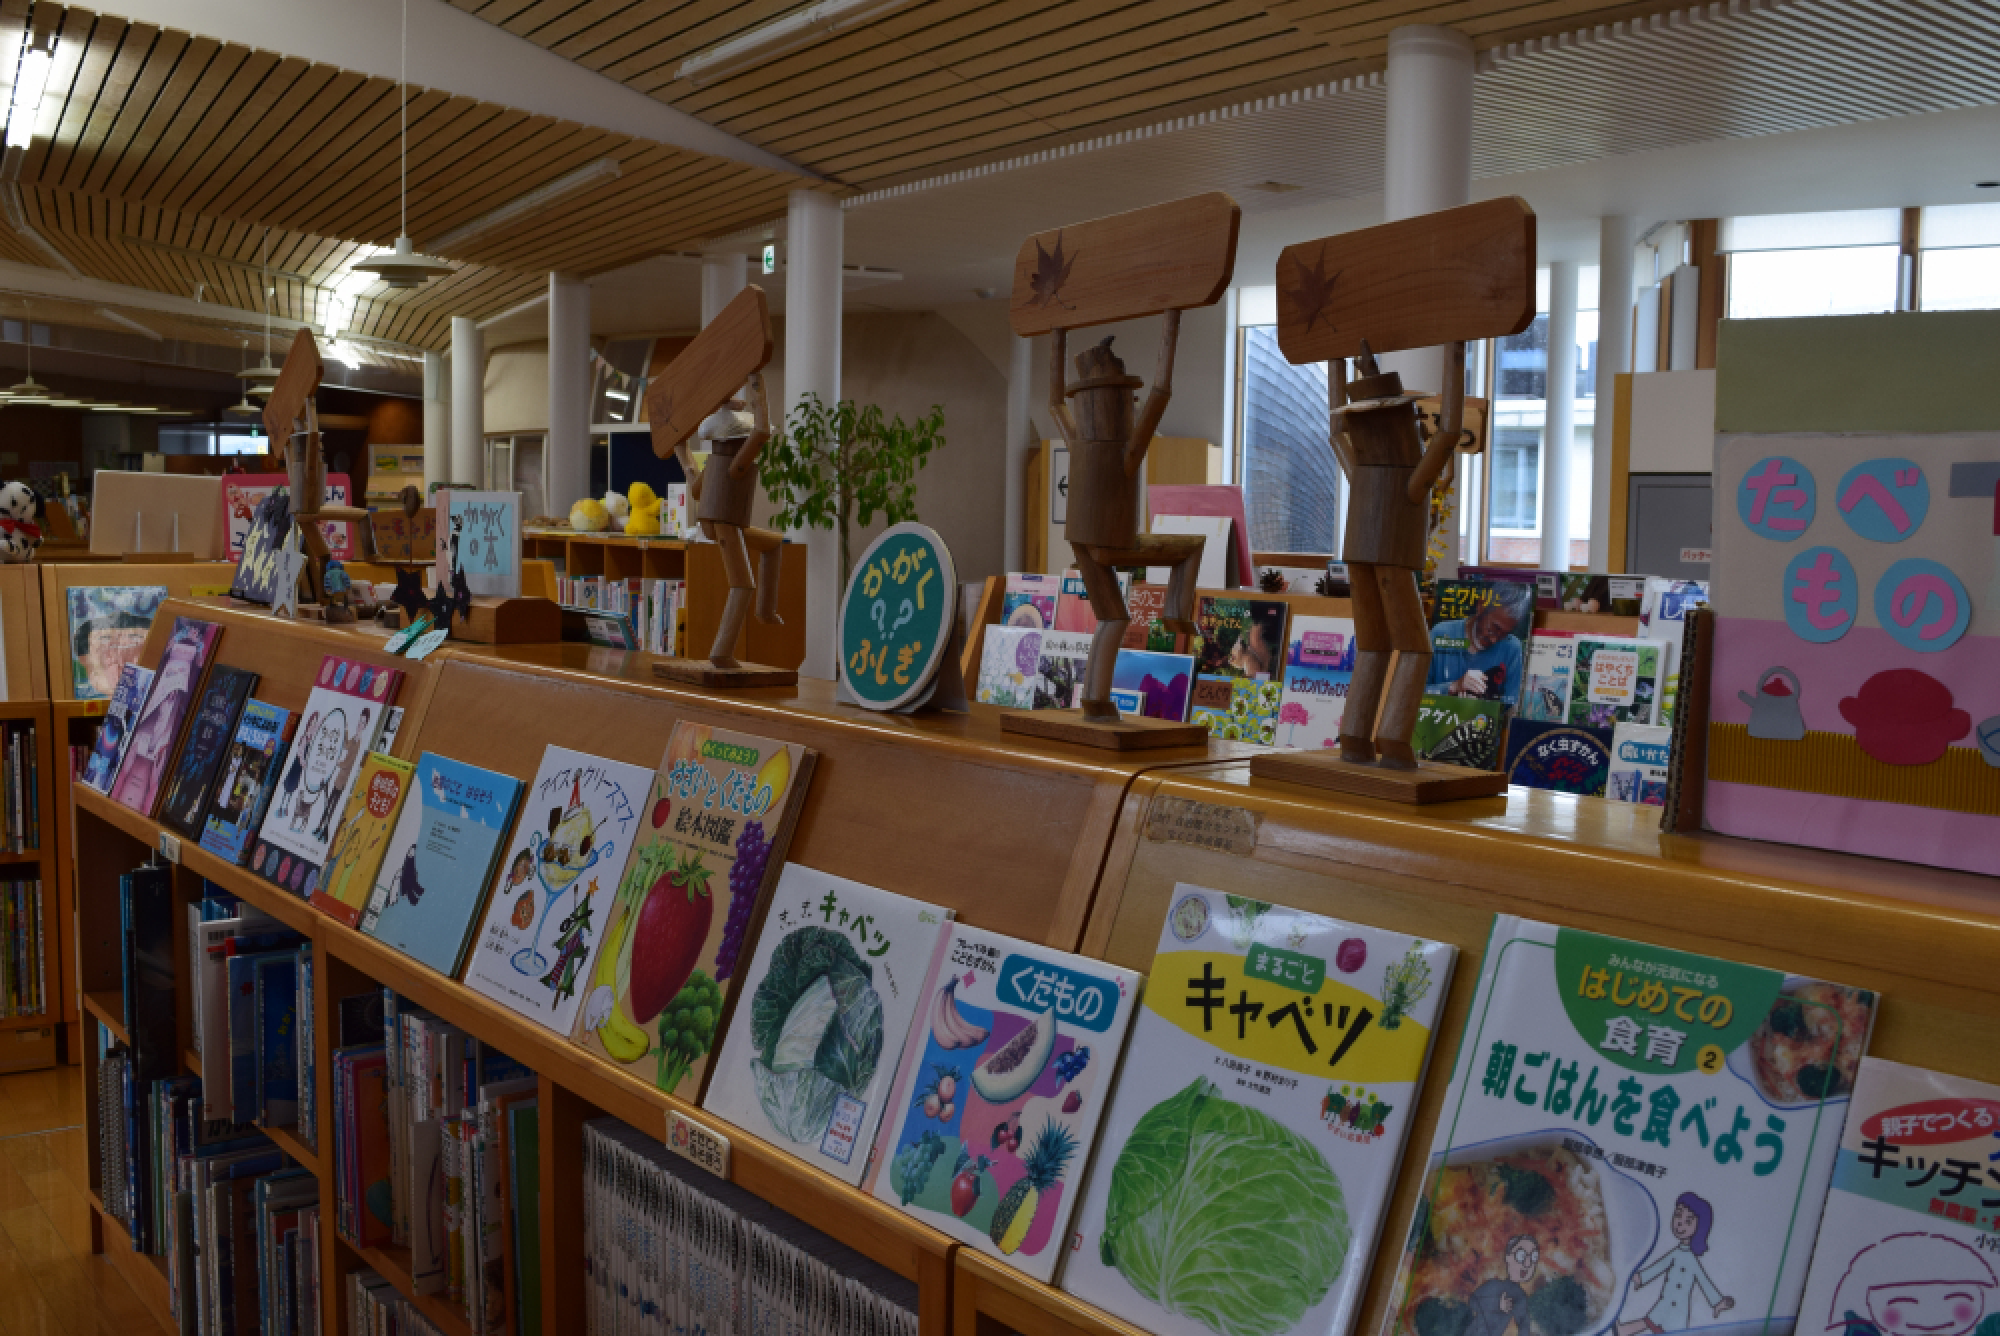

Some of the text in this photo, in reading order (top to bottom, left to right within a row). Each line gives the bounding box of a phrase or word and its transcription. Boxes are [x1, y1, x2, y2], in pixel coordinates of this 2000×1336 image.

[1746, 459, 1921, 535] たべ
[862, 547, 935, 610] かがく
[1441, 586, 1502, 607] ニワトリと
[1791, 552, 1959, 642] もの
[849, 637, 923, 686] ふしぎ
[1417, 707, 1461, 727] アゲハ
[1010, 965, 1103, 1022] くだもの
[1254, 951, 1316, 986] まるごと
[1185, 961, 1374, 1066] キャベツ
[1577, 964, 1735, 1029] はじめての
[1599, 1014, 1689, 1068] 食育
[1703, 1050, 1718, 1070] 2
[1481, 1039, 1788, 1177] 朝ごはんを食べよう
[1880, 1107, 1994, 1138] 親子でつくる
